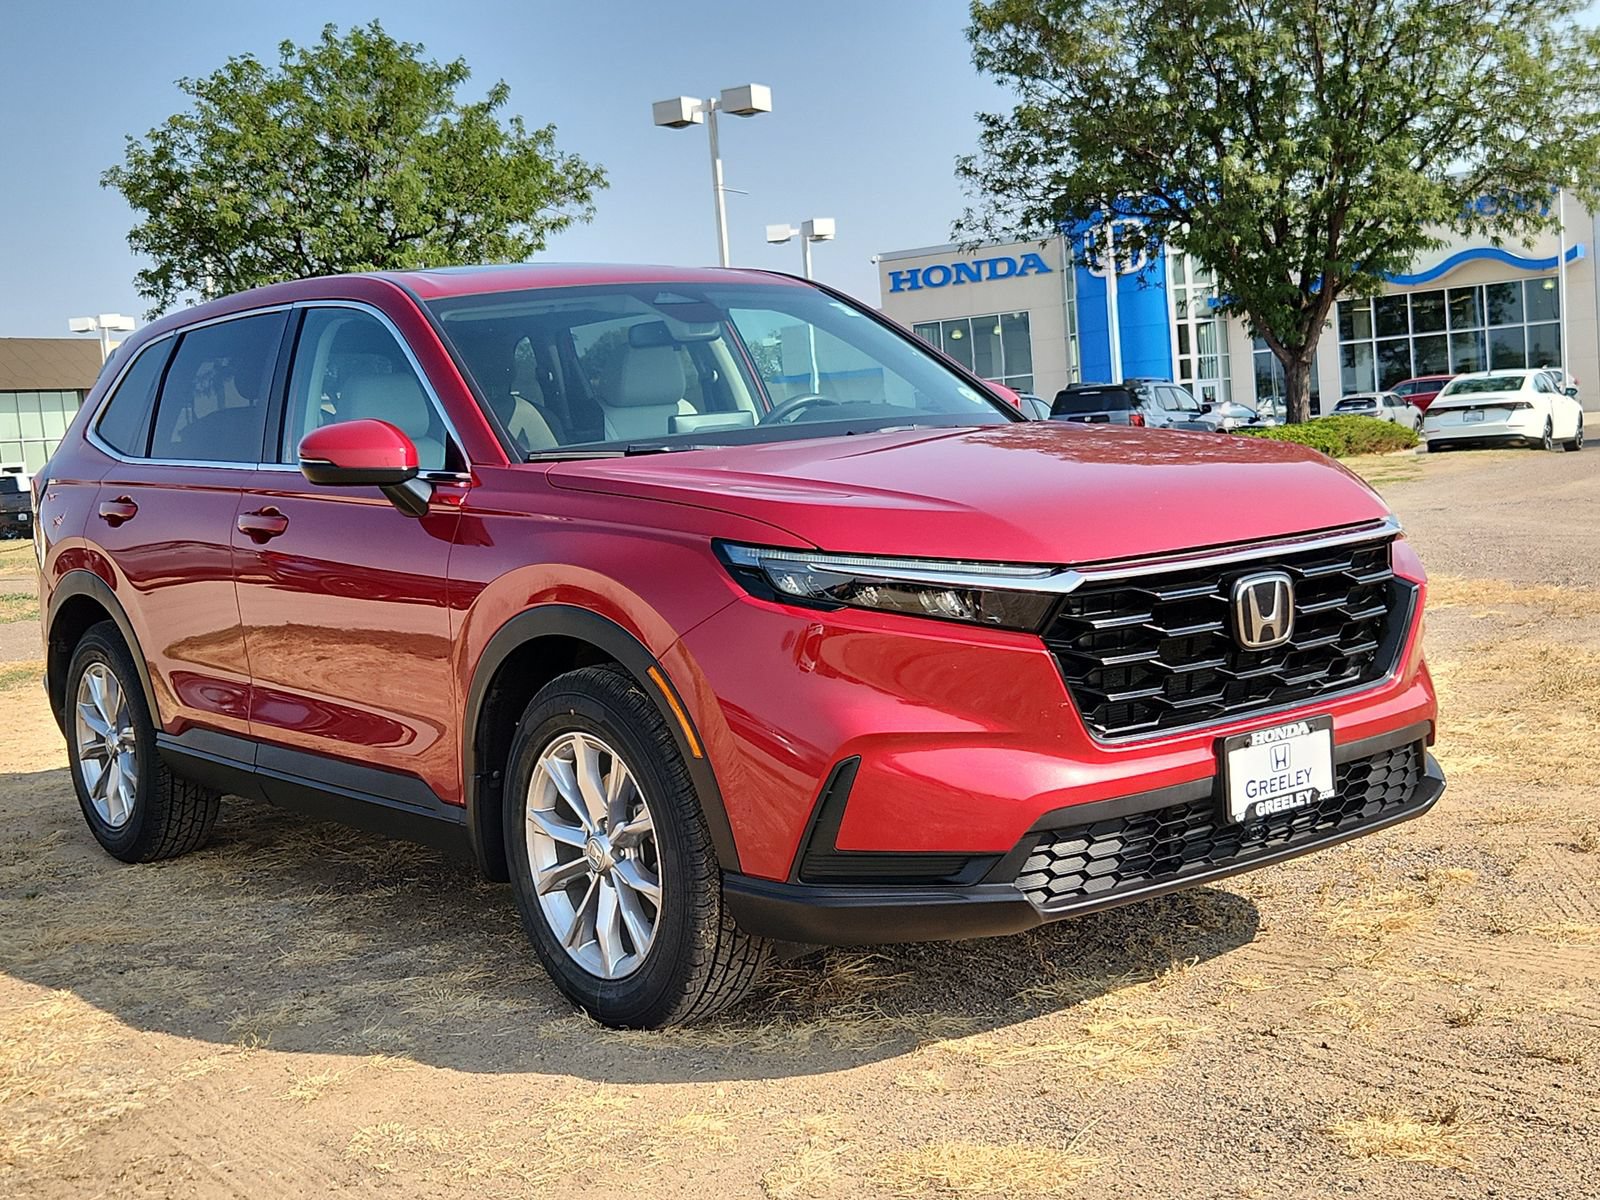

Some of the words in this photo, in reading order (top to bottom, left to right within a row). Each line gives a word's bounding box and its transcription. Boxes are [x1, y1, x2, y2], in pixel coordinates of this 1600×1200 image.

[888, 253, 1053, 293] HONDA
[1251, 721, 1310, 746] HONDA
[1245, 767, 1312, 798] GREELEY
[1255, 790, 1313, 816] GREELEY
